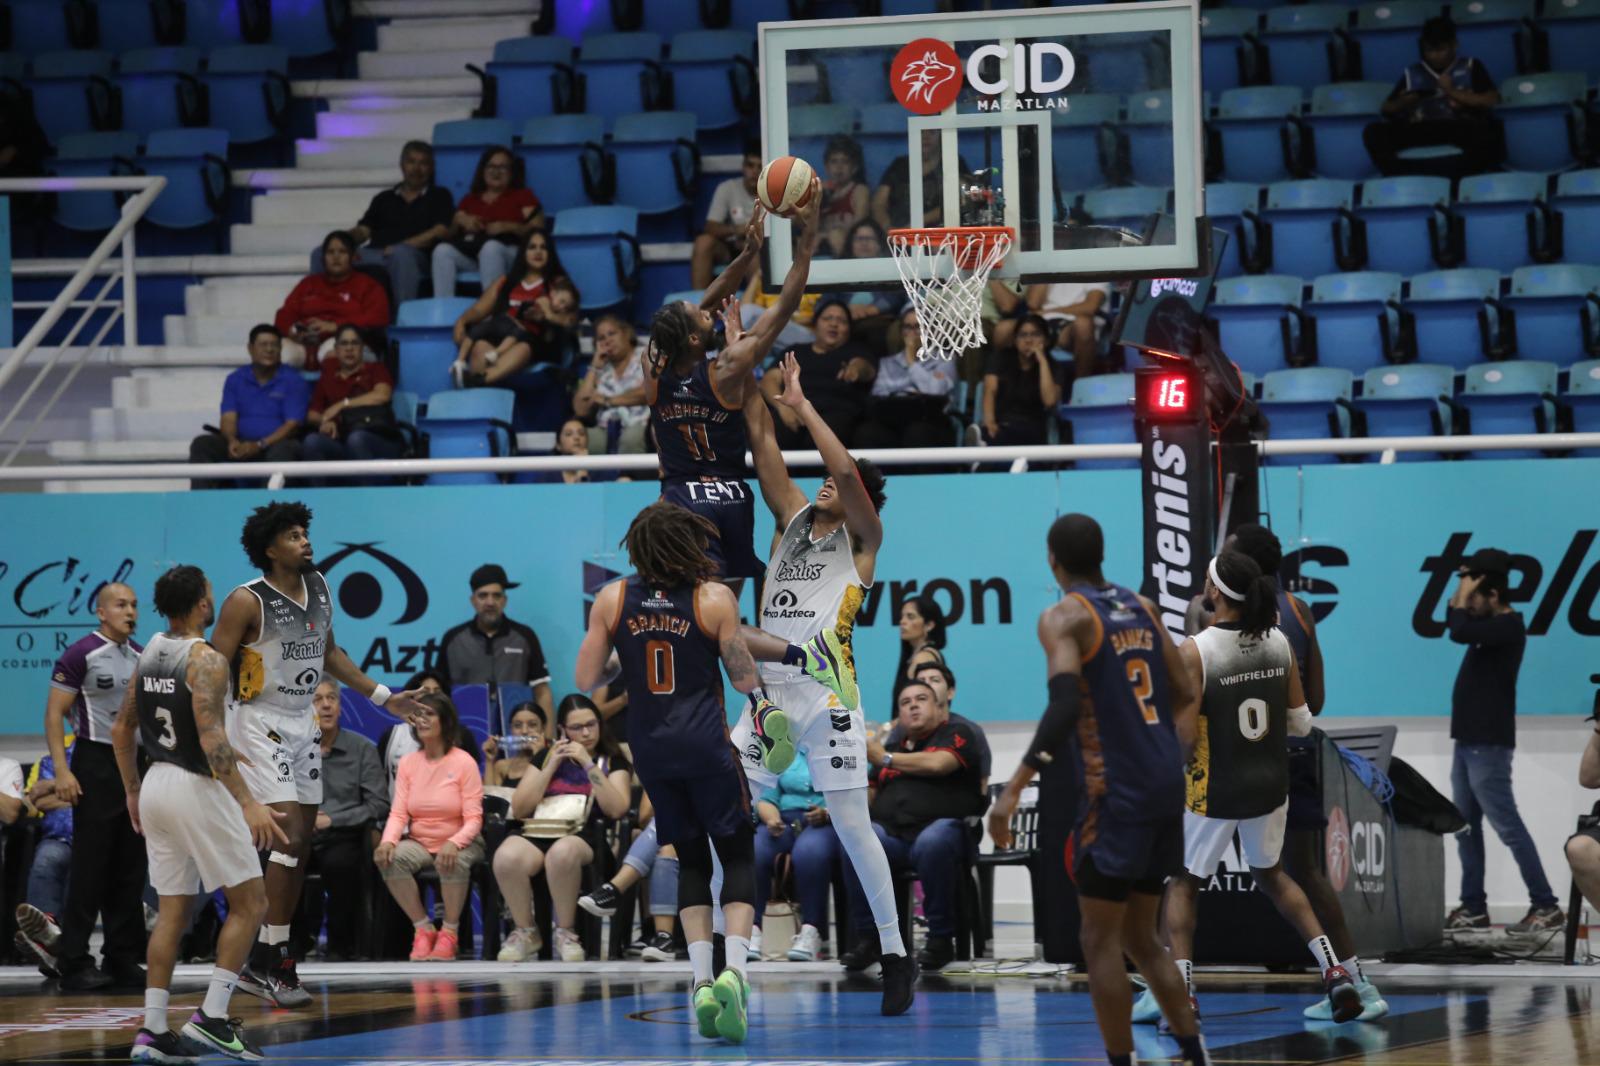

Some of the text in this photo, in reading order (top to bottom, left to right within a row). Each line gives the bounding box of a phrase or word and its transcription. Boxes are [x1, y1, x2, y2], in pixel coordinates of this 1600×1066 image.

[966, 42, 1075, 95] CID
[977, 97, 1068, 111] MAZATLAN
[1159, 379, 1185, 407] 16
[677, 423, 716, 462] 11
[686, 481, 745, 501] TENT
[1152, 440, 1192, 646] ortenis
[626, 614, 691, 638] BRANCH
[780, 609, 815, 618] Azteca
[646, 640, 675, 694] 0
[1220, 669, 1275, 686] WHITFIELD
[1126, 658, 1160, 725] 2
[155, 706, 177, 751] 3
[1238, 698, 1269, 741] 0
[1351, 821, 1386, 877] CID
